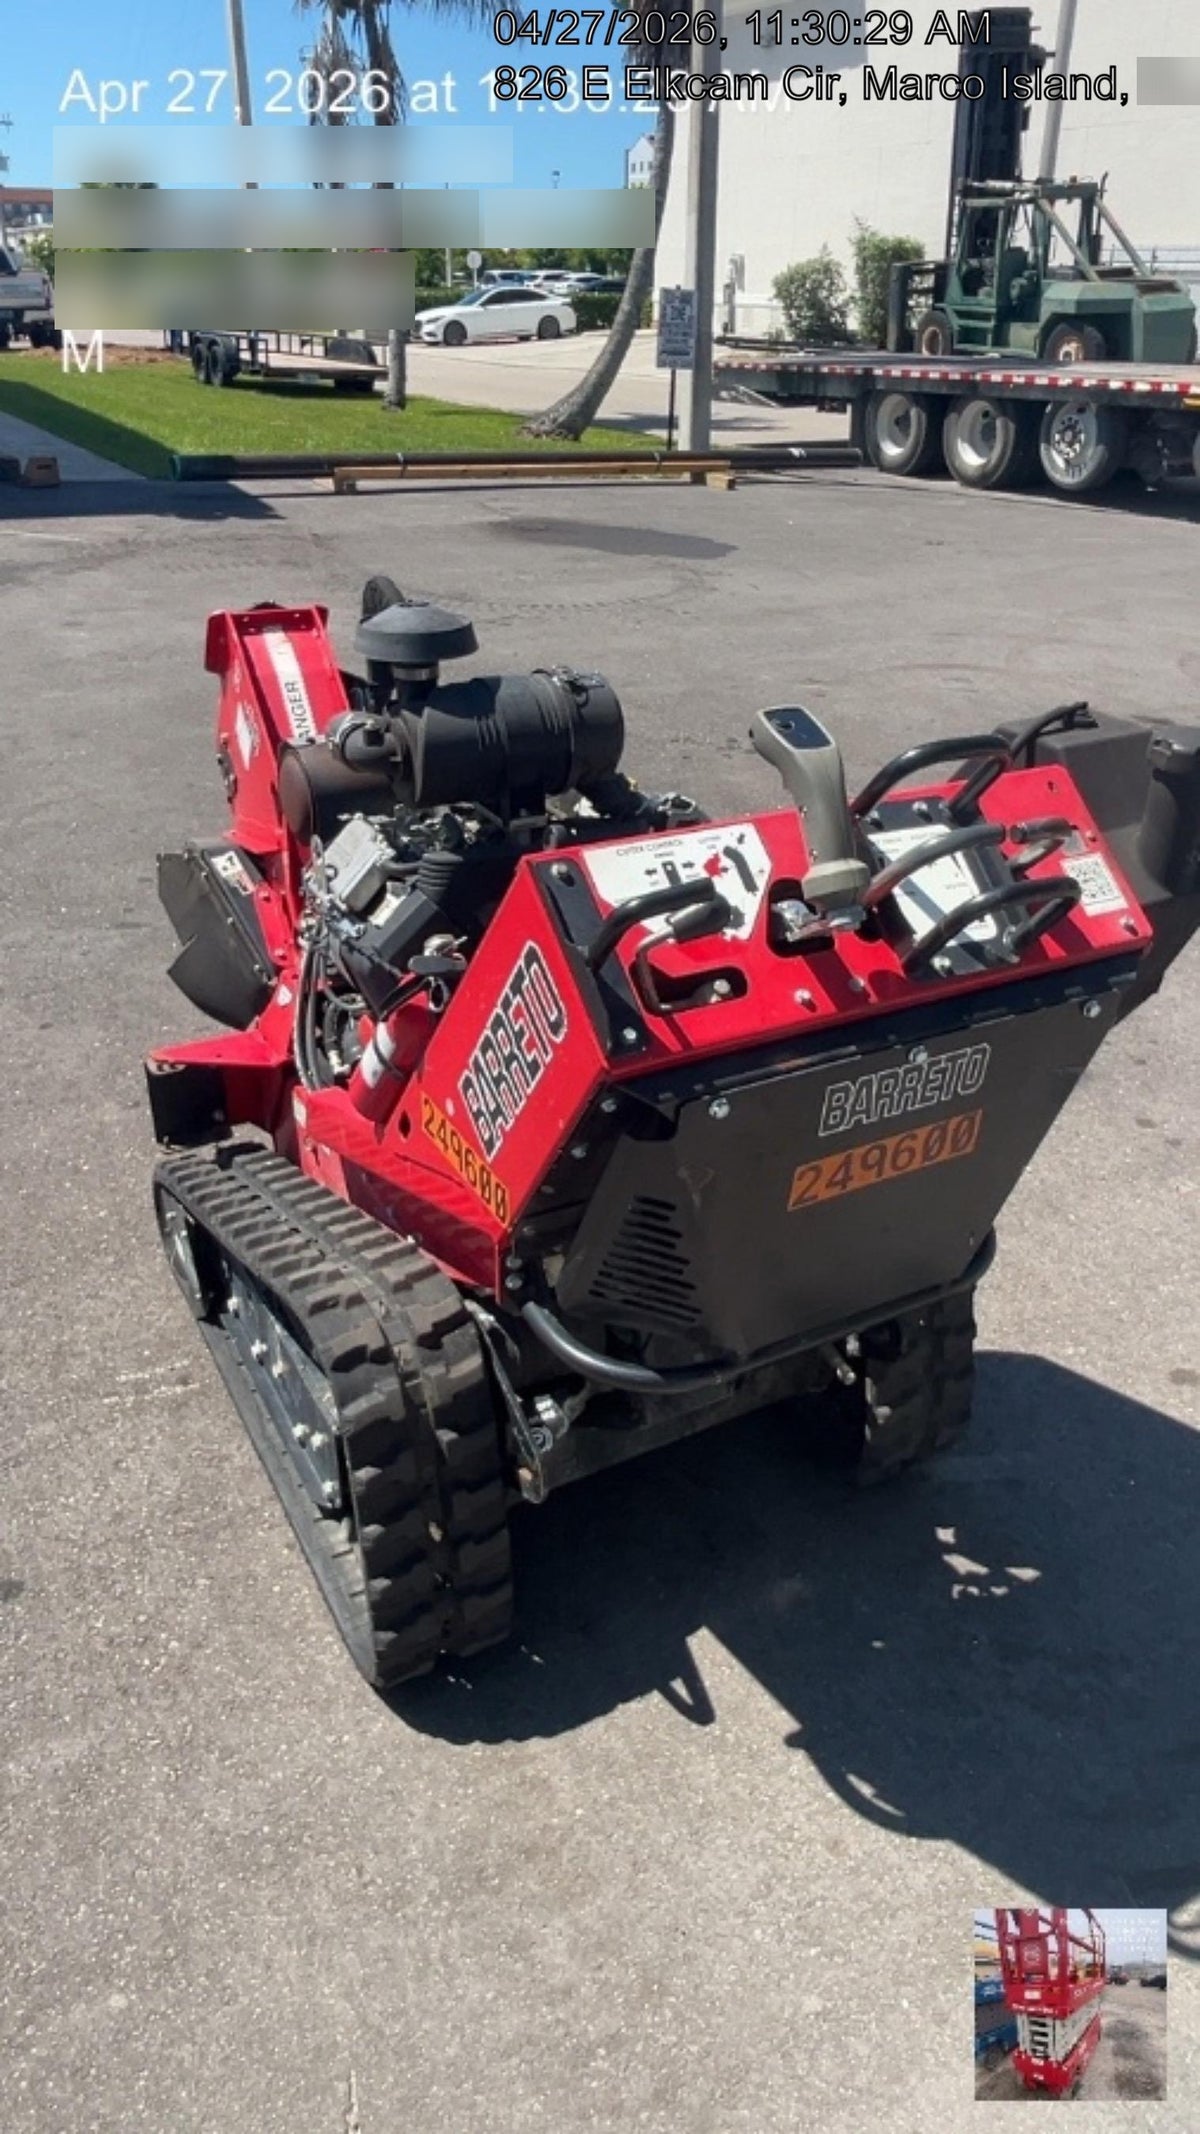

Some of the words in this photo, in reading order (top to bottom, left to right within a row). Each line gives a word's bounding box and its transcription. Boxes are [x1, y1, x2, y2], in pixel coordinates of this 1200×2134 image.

[284, 680, 314, 742] ANGER
[457, 940, 568, 1163] BARRETO
[817, 1042, 992, 1138] BARRETO
[422, 1096, 509, 1226] 249600
[790, 1114, 977, 1210] 249600
